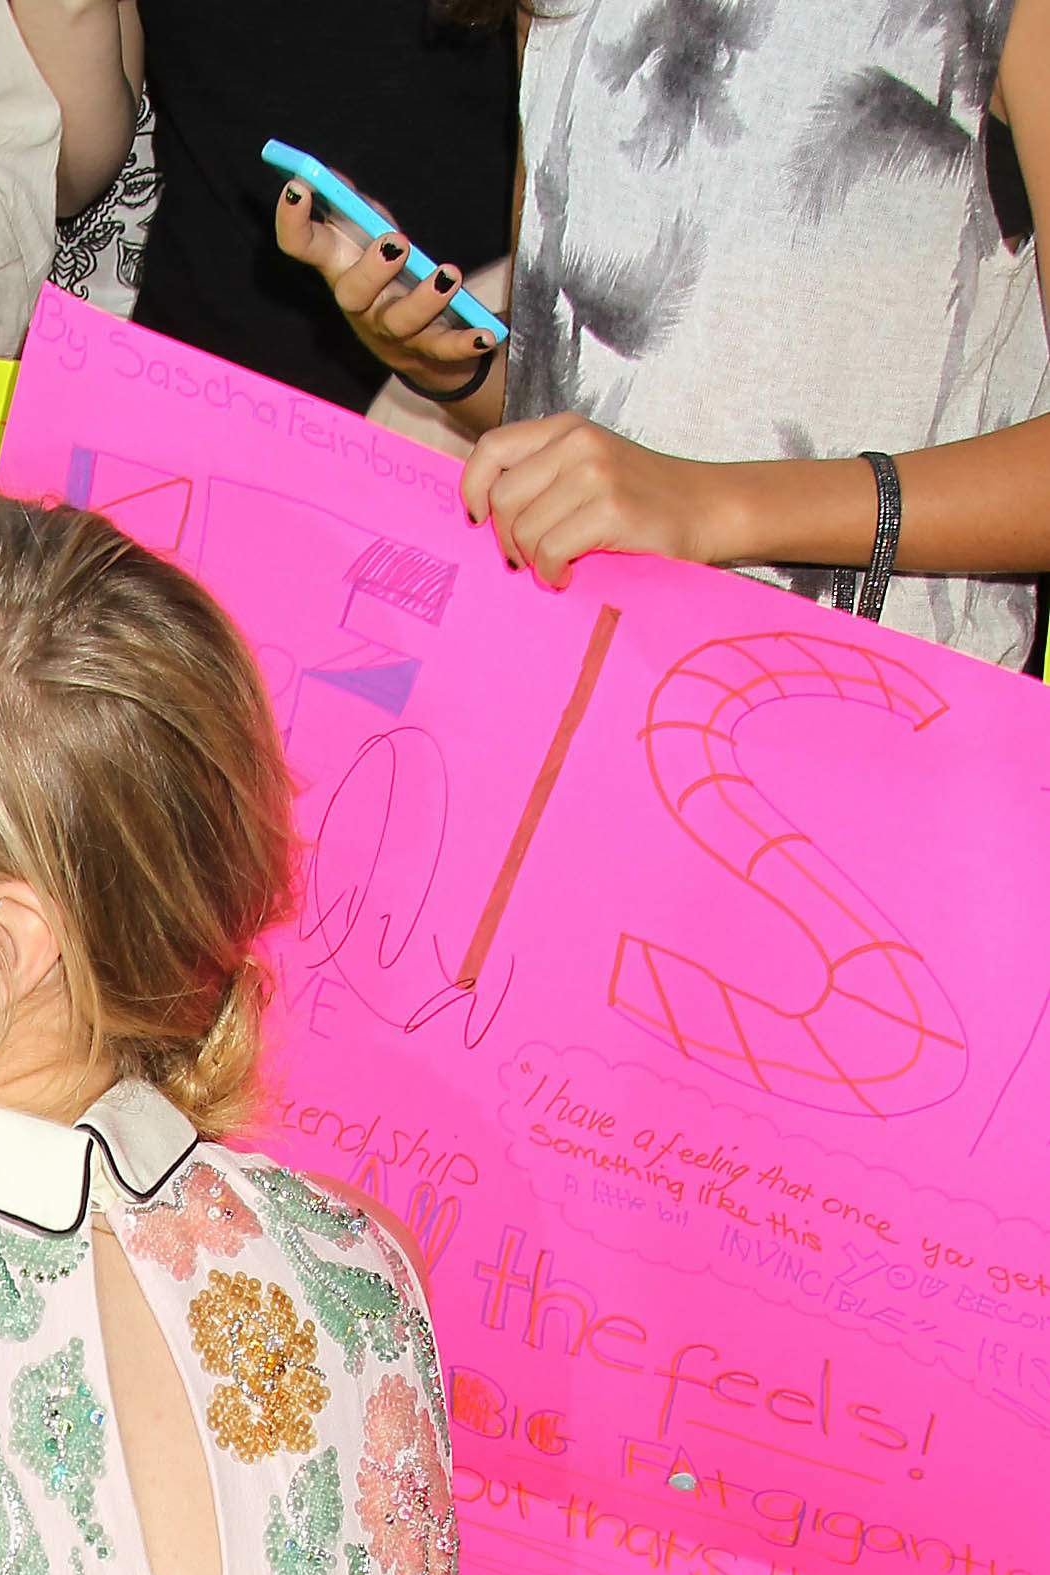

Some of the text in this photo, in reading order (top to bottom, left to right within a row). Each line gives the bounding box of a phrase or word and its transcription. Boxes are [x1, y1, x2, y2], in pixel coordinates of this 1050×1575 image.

[35, 297, 87, 372] By
[108, 330, 279, 428] Sascha
[527, 1122, 685, 1202] something
[698, 1178, 761, 1227] like
[765, 1211, 823, 1253] this
[543, 1077, 616, 1138] have
[632, 1128, 656, 1151] a
[645, 1131, 752, 1191] feeling
[756, 1164, 814, 1203] that
[821, 1197, 901, 1244] once
[986, 1265, 1050, 1297] get
[450, 1365, 577, 1456] BIG
[473, 1223, 647, 1376] the
[654, 1343, 936, 1480] feels!
